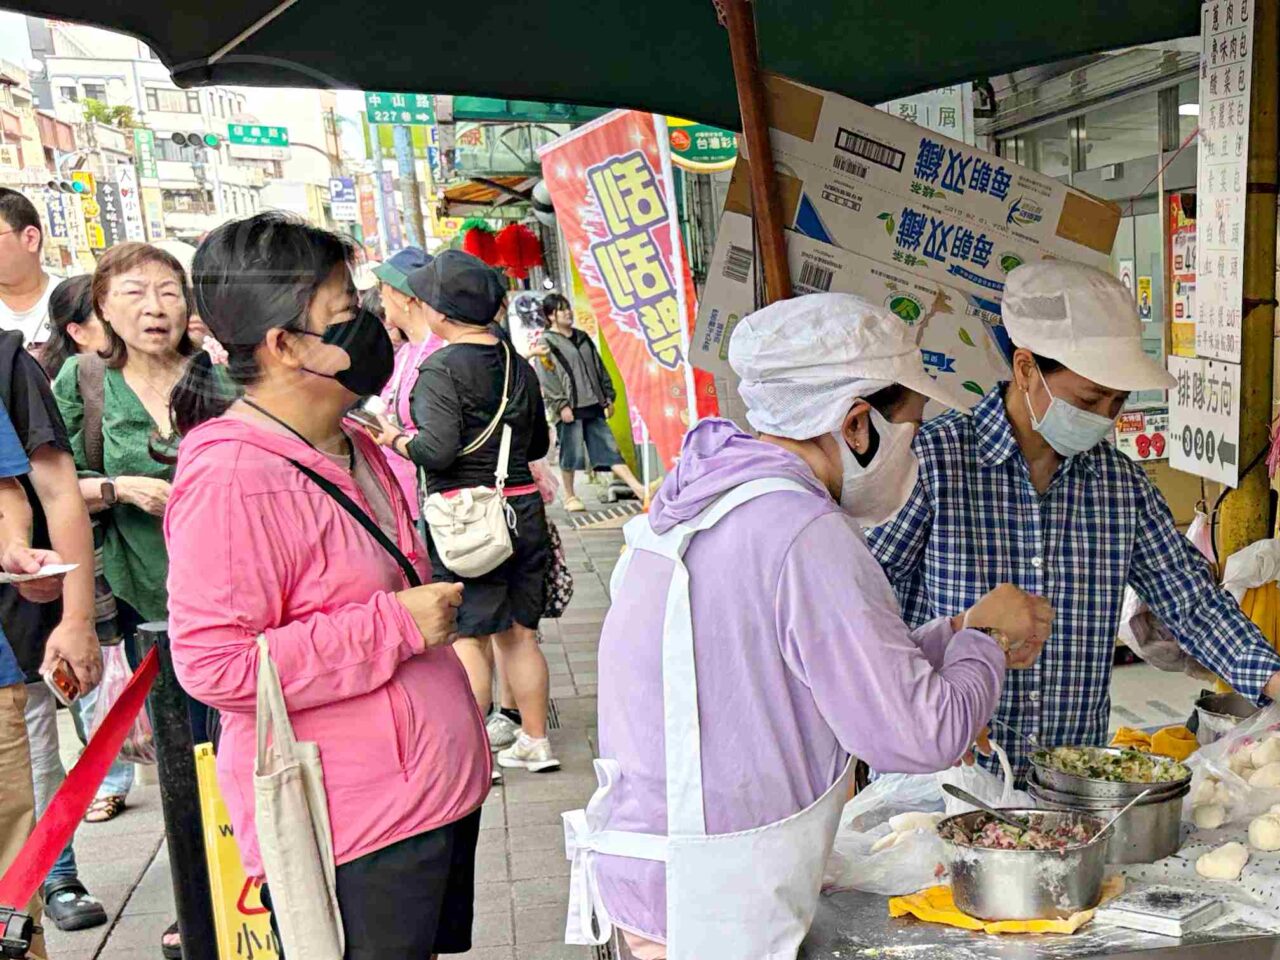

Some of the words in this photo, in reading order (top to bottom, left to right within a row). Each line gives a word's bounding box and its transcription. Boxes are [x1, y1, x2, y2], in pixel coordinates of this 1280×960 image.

[368, 93, 429, 108] 中山路
[696, 136, 738, 150] 台灣彩
[1178, 368, 1231, 416] 排隊方向
